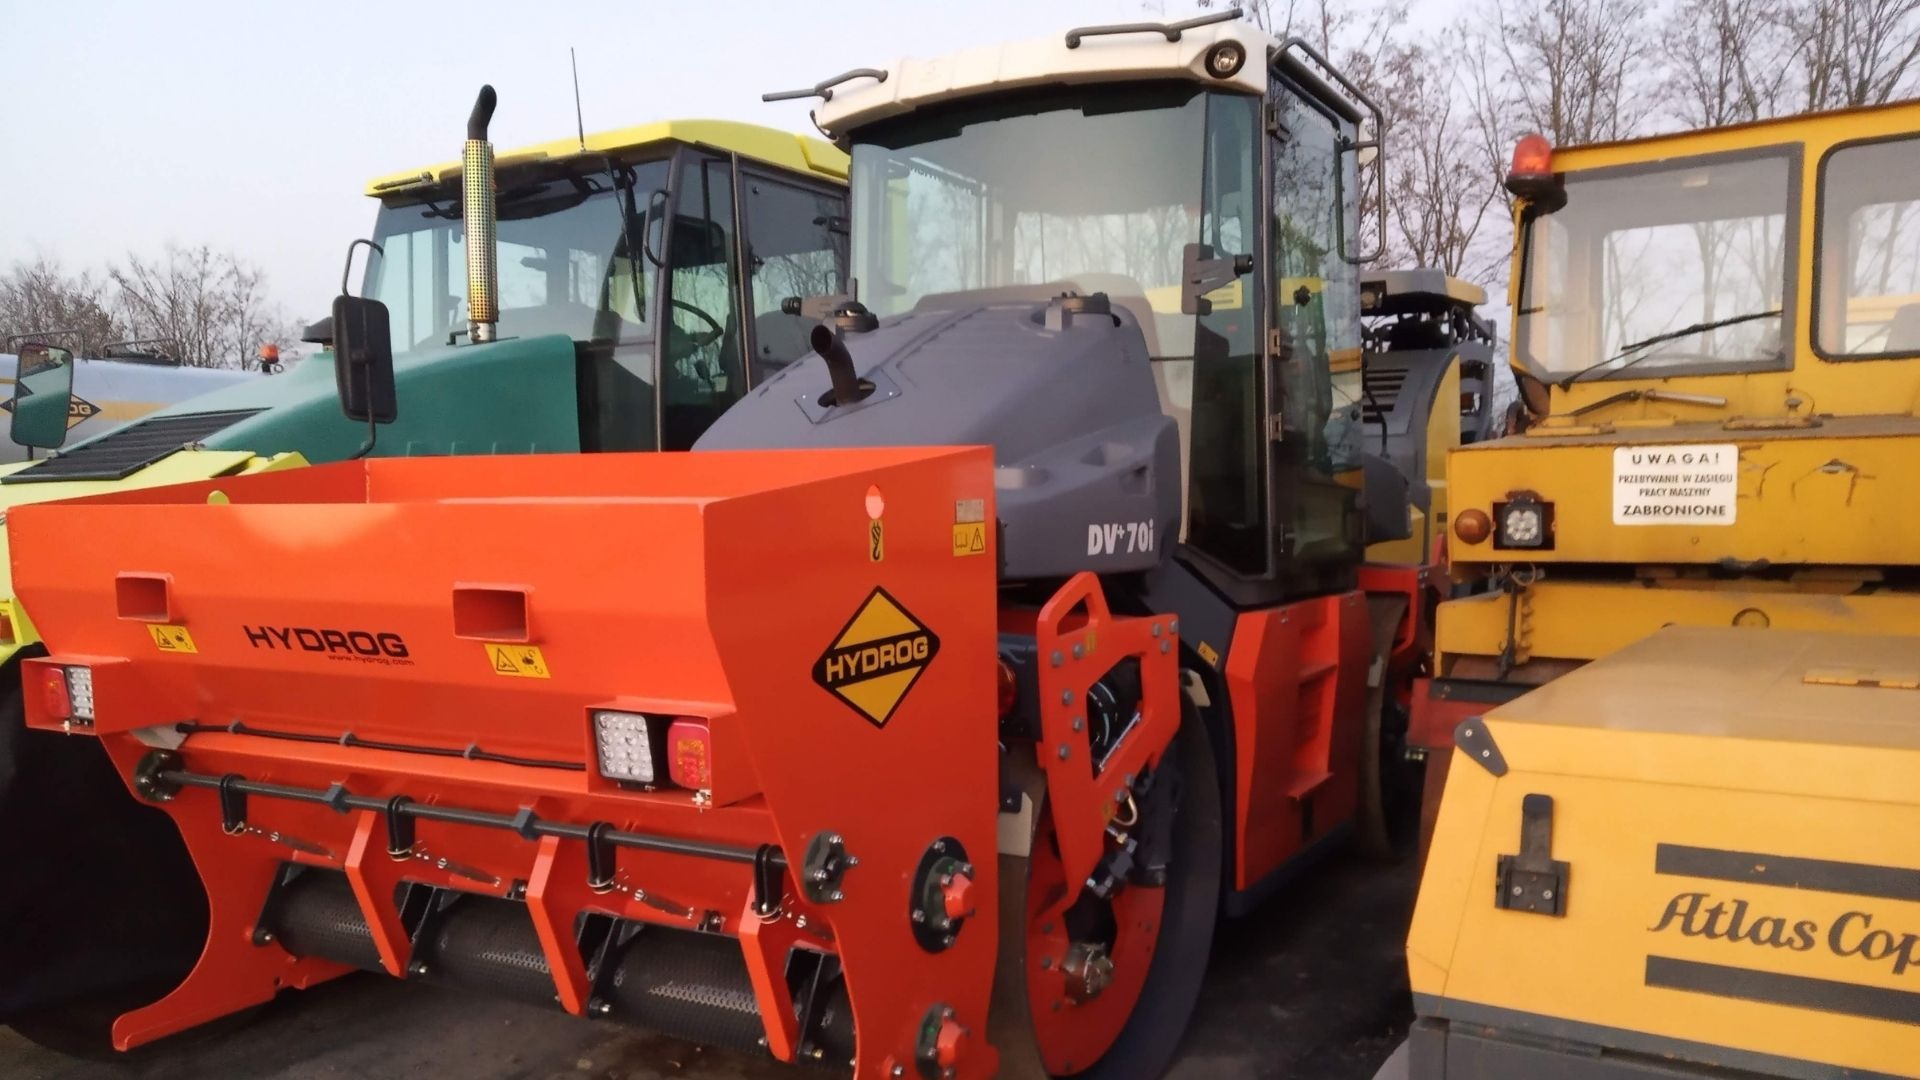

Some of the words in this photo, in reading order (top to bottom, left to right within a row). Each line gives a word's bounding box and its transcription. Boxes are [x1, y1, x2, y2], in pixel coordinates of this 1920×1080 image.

[1632, 452, 1719, 465] UWAGA!
[1618, 474, 1679, 484] PRZEBYWANIE
[1682, 474, 1692, 483] W
[1639, 487, 1667, 497] PRACY
[1669, 487, 1711, 497] MASZYNY
[1623, 504, 1726, 516] ZABRONIONE
[243, 625, 409, 657] HYDROG
[826, 636, 929, 683] HYDROG
[1647, 892, 1818, 951] Atlas
